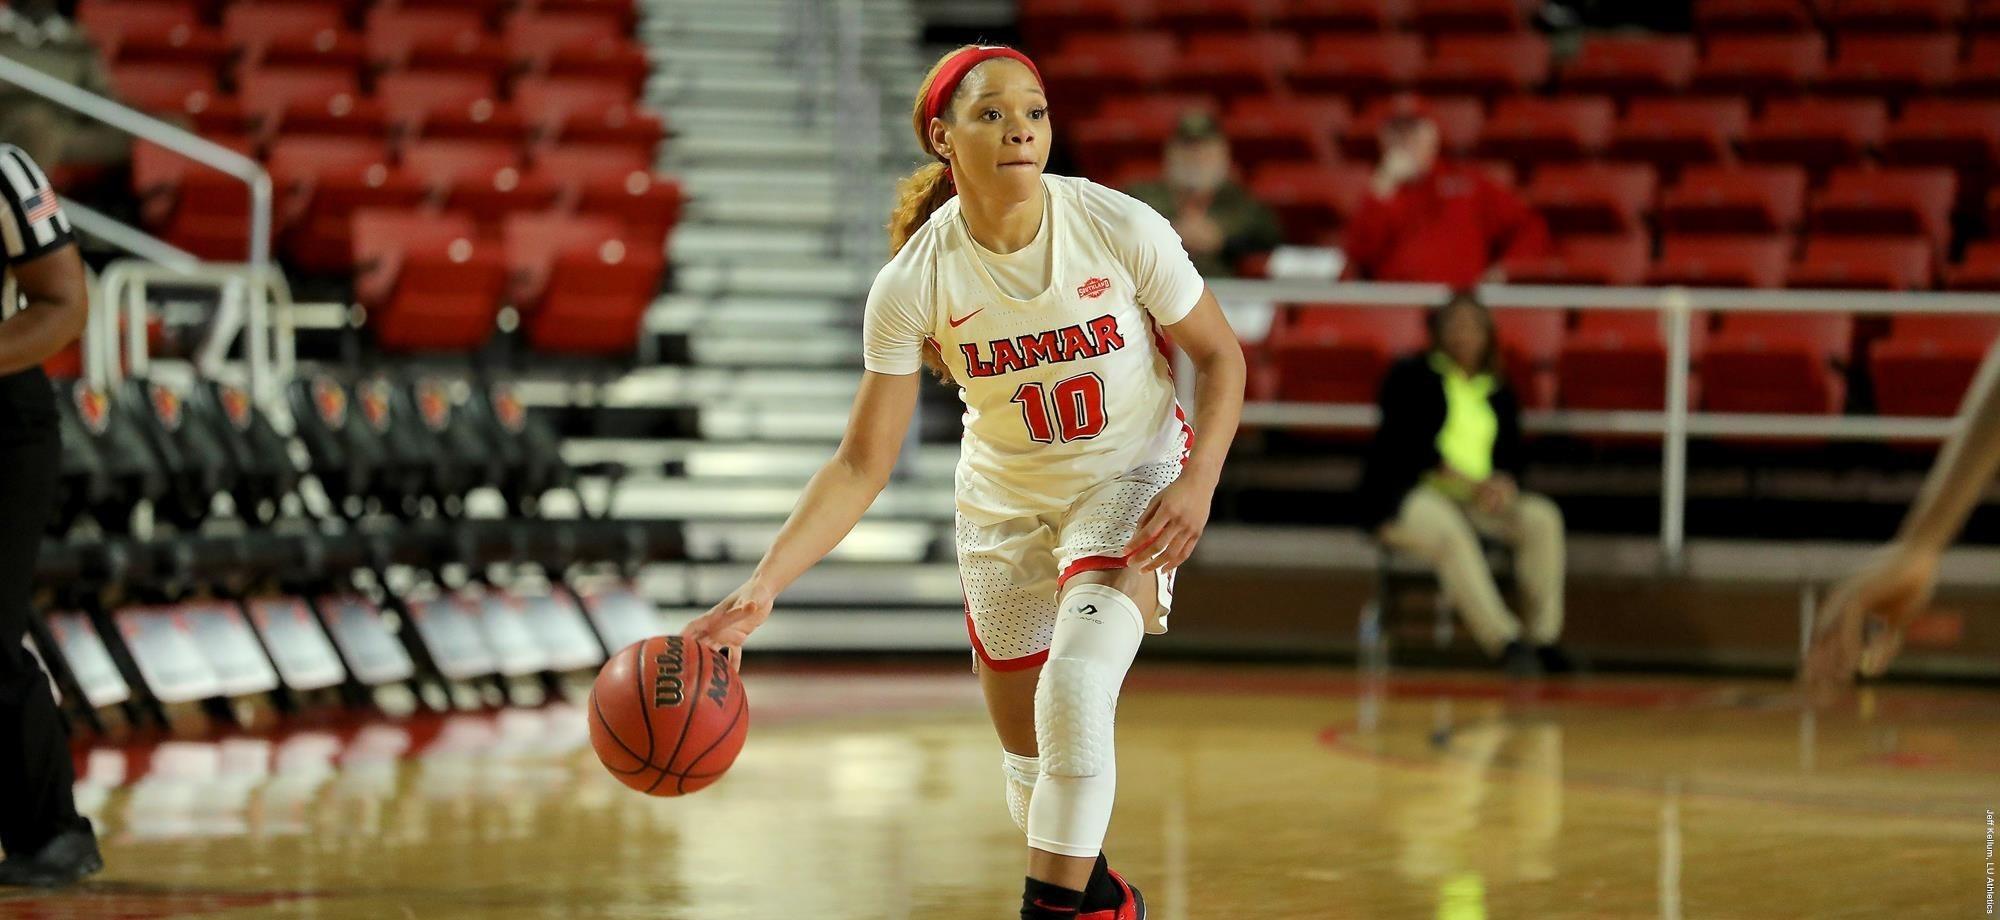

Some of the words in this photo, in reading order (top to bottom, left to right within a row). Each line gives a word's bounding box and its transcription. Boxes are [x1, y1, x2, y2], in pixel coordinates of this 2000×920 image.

[959, 314, 1125, 378] LAMAR
[1010, 372, 1108, 444] 10
[654, 636, 684, 708] Wilso
